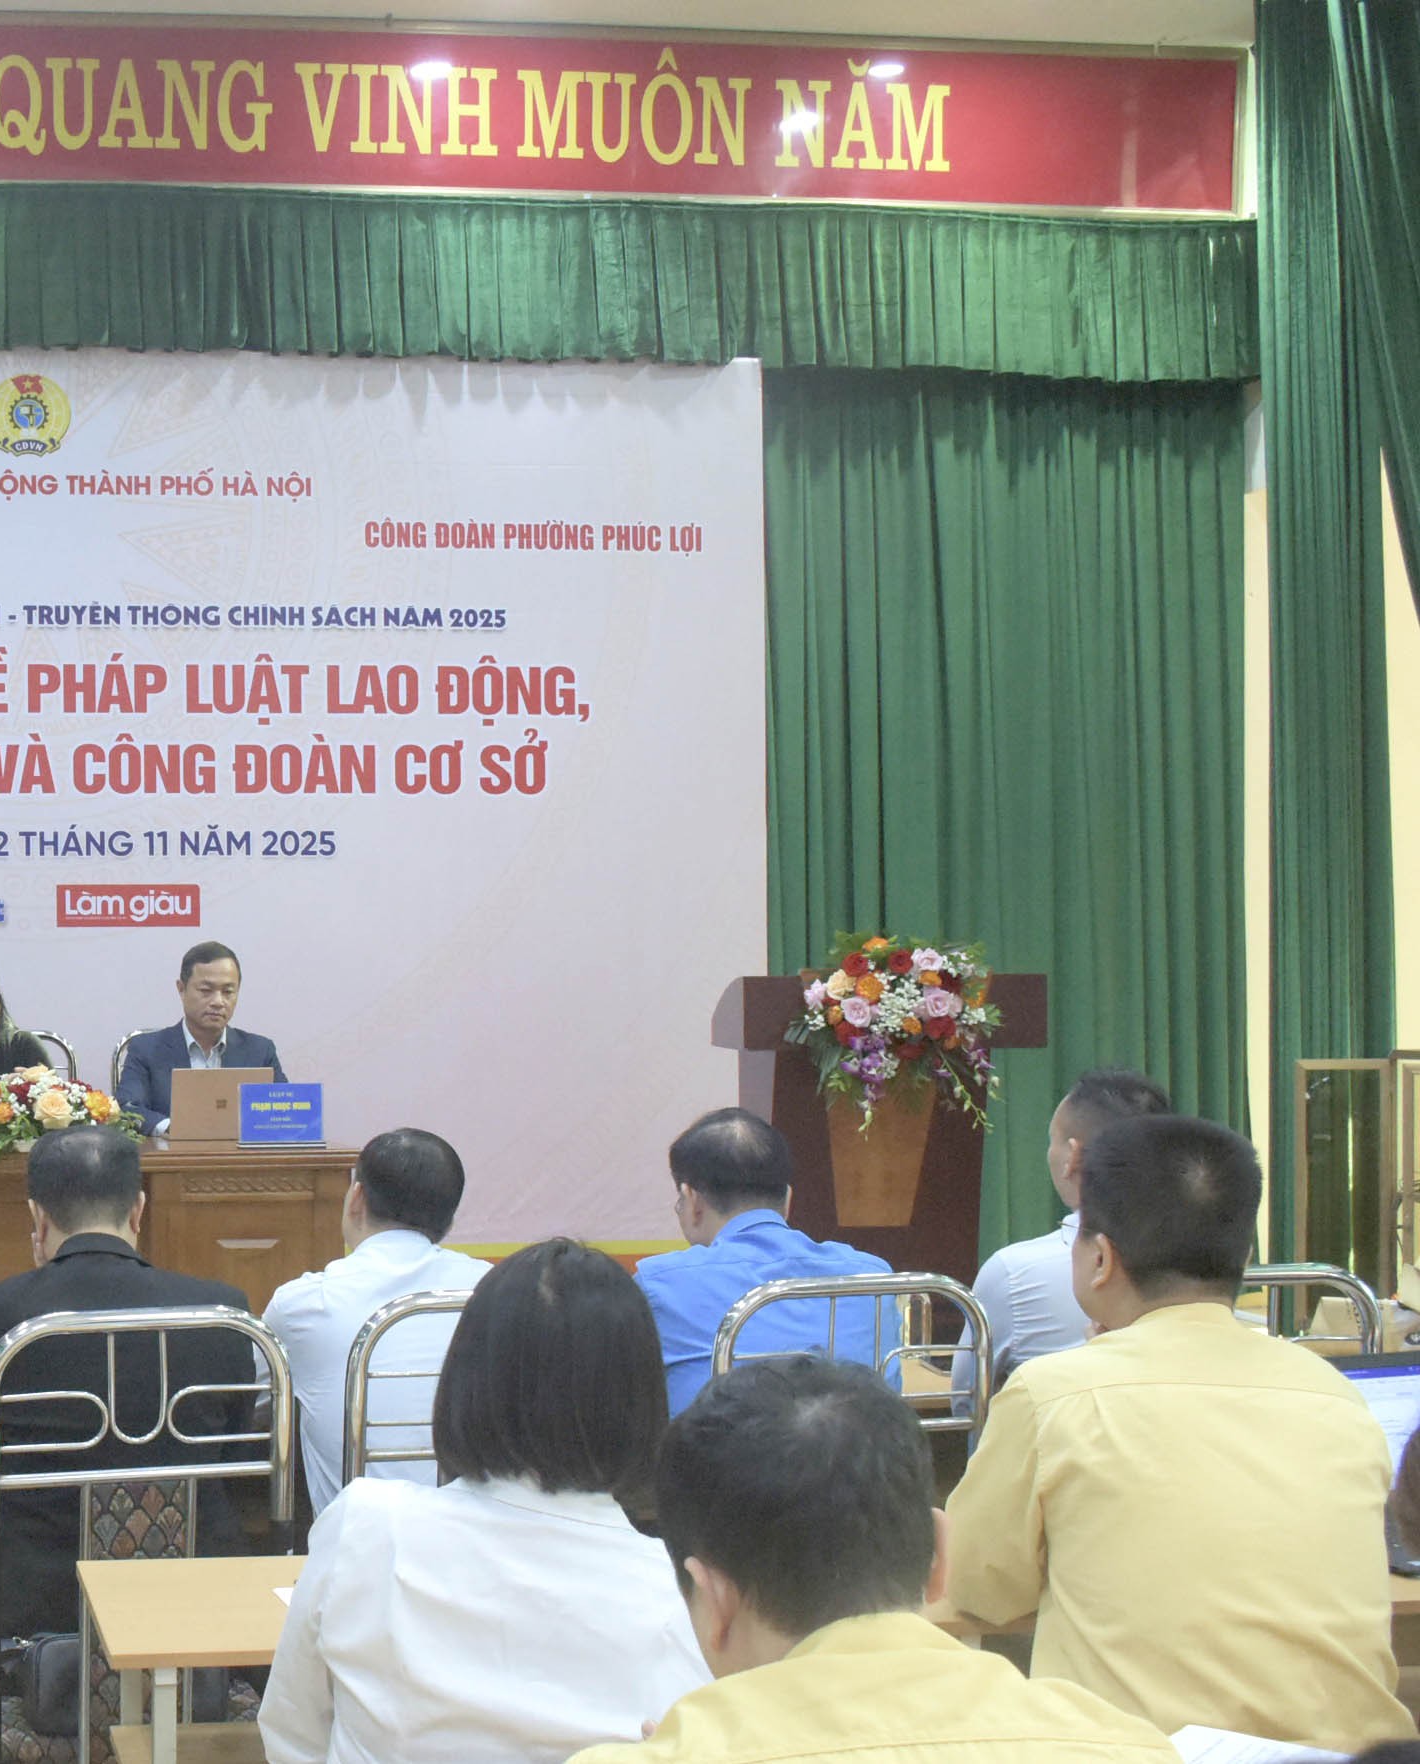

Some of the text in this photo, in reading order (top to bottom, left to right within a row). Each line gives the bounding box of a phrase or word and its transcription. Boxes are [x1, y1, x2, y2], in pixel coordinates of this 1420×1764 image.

[294, 61, 500, 159] VINH
[516, 46, 752, 168] MUÔN
[774, 59, 952, 174] NĂM
[66, 469, 152, 497] THÀNH
[160, 466, 214, 497] PHỐ
[222, 470, 259, 498] HÀ
[267, 472, 312, 502] NỘI
[364, 517, 703, 555] CÔNG ĐOÀN PHƯỜNG PHÚC LỢI
[126, 604, 221, 627] THÔNG
[227, 604, 305, 627] CHÍNH
[311, 605, 376, 627] SÁCH
[449, 608, 507, 629] 2025
[27, 653, 167, 714] PHÁP
[186, 653, 309, 725] LUẬT
[327, 664, 419, 715] LAO
[435, 655, 590, 727] ĐỘNG,
[73, 733, 217, 795] CÔNG
[233, 735, 377, 794] ĐOÀN
[395, 739, 464, 795] CƠ
[480, 727, 549, 796] SỞ
[18, 824, 134, 857] THÁNG
[143, 830, 168, 857] 11
[180, 824, 251, 857] NĂM
[261, 830, 337, 857] 2025
[64, 888, 125, 916] Làm
